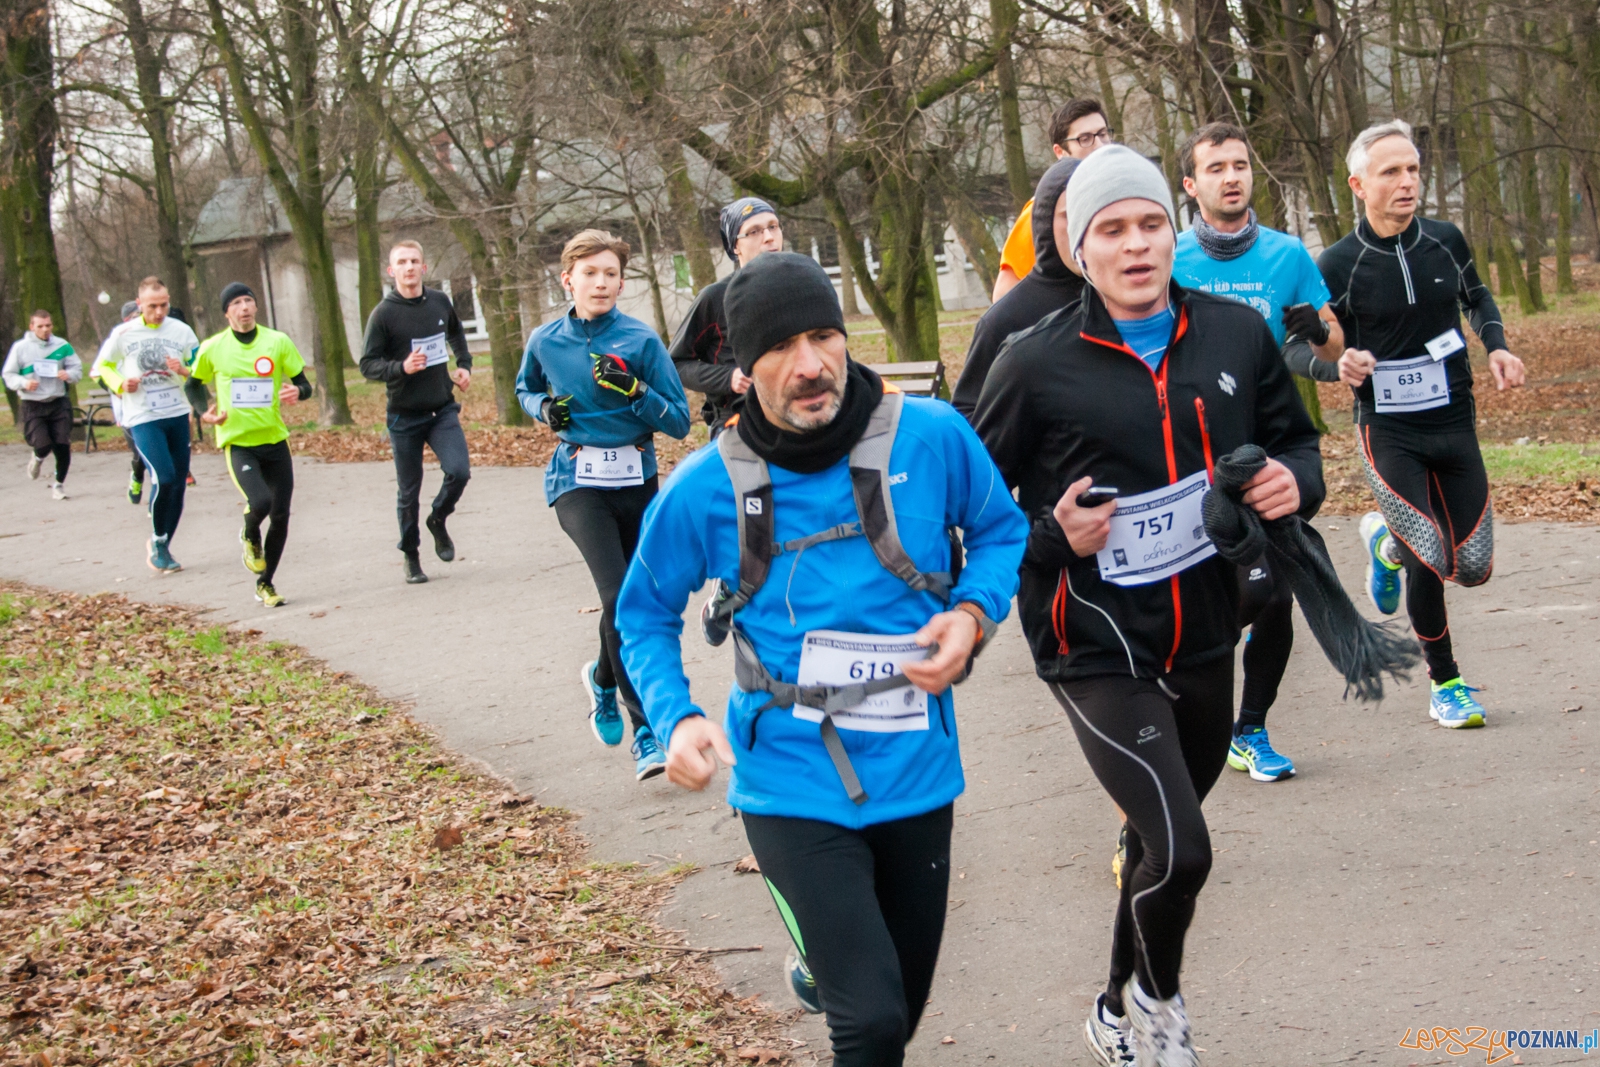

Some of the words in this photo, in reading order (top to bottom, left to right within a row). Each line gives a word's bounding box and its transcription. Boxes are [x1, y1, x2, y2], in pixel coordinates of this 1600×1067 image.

[248, 384, 258, 392] 32
[1398, 372, 1423, 385] 633
[603, 451, 617, 461] 13
[1149, 481, 1204, 509] WIELKOPOLSKIEGO
[1132, 511, 1174, 539] 757
[1143, 540, 1183, 563] parkrun
[849, 660, 895, 681] 619
